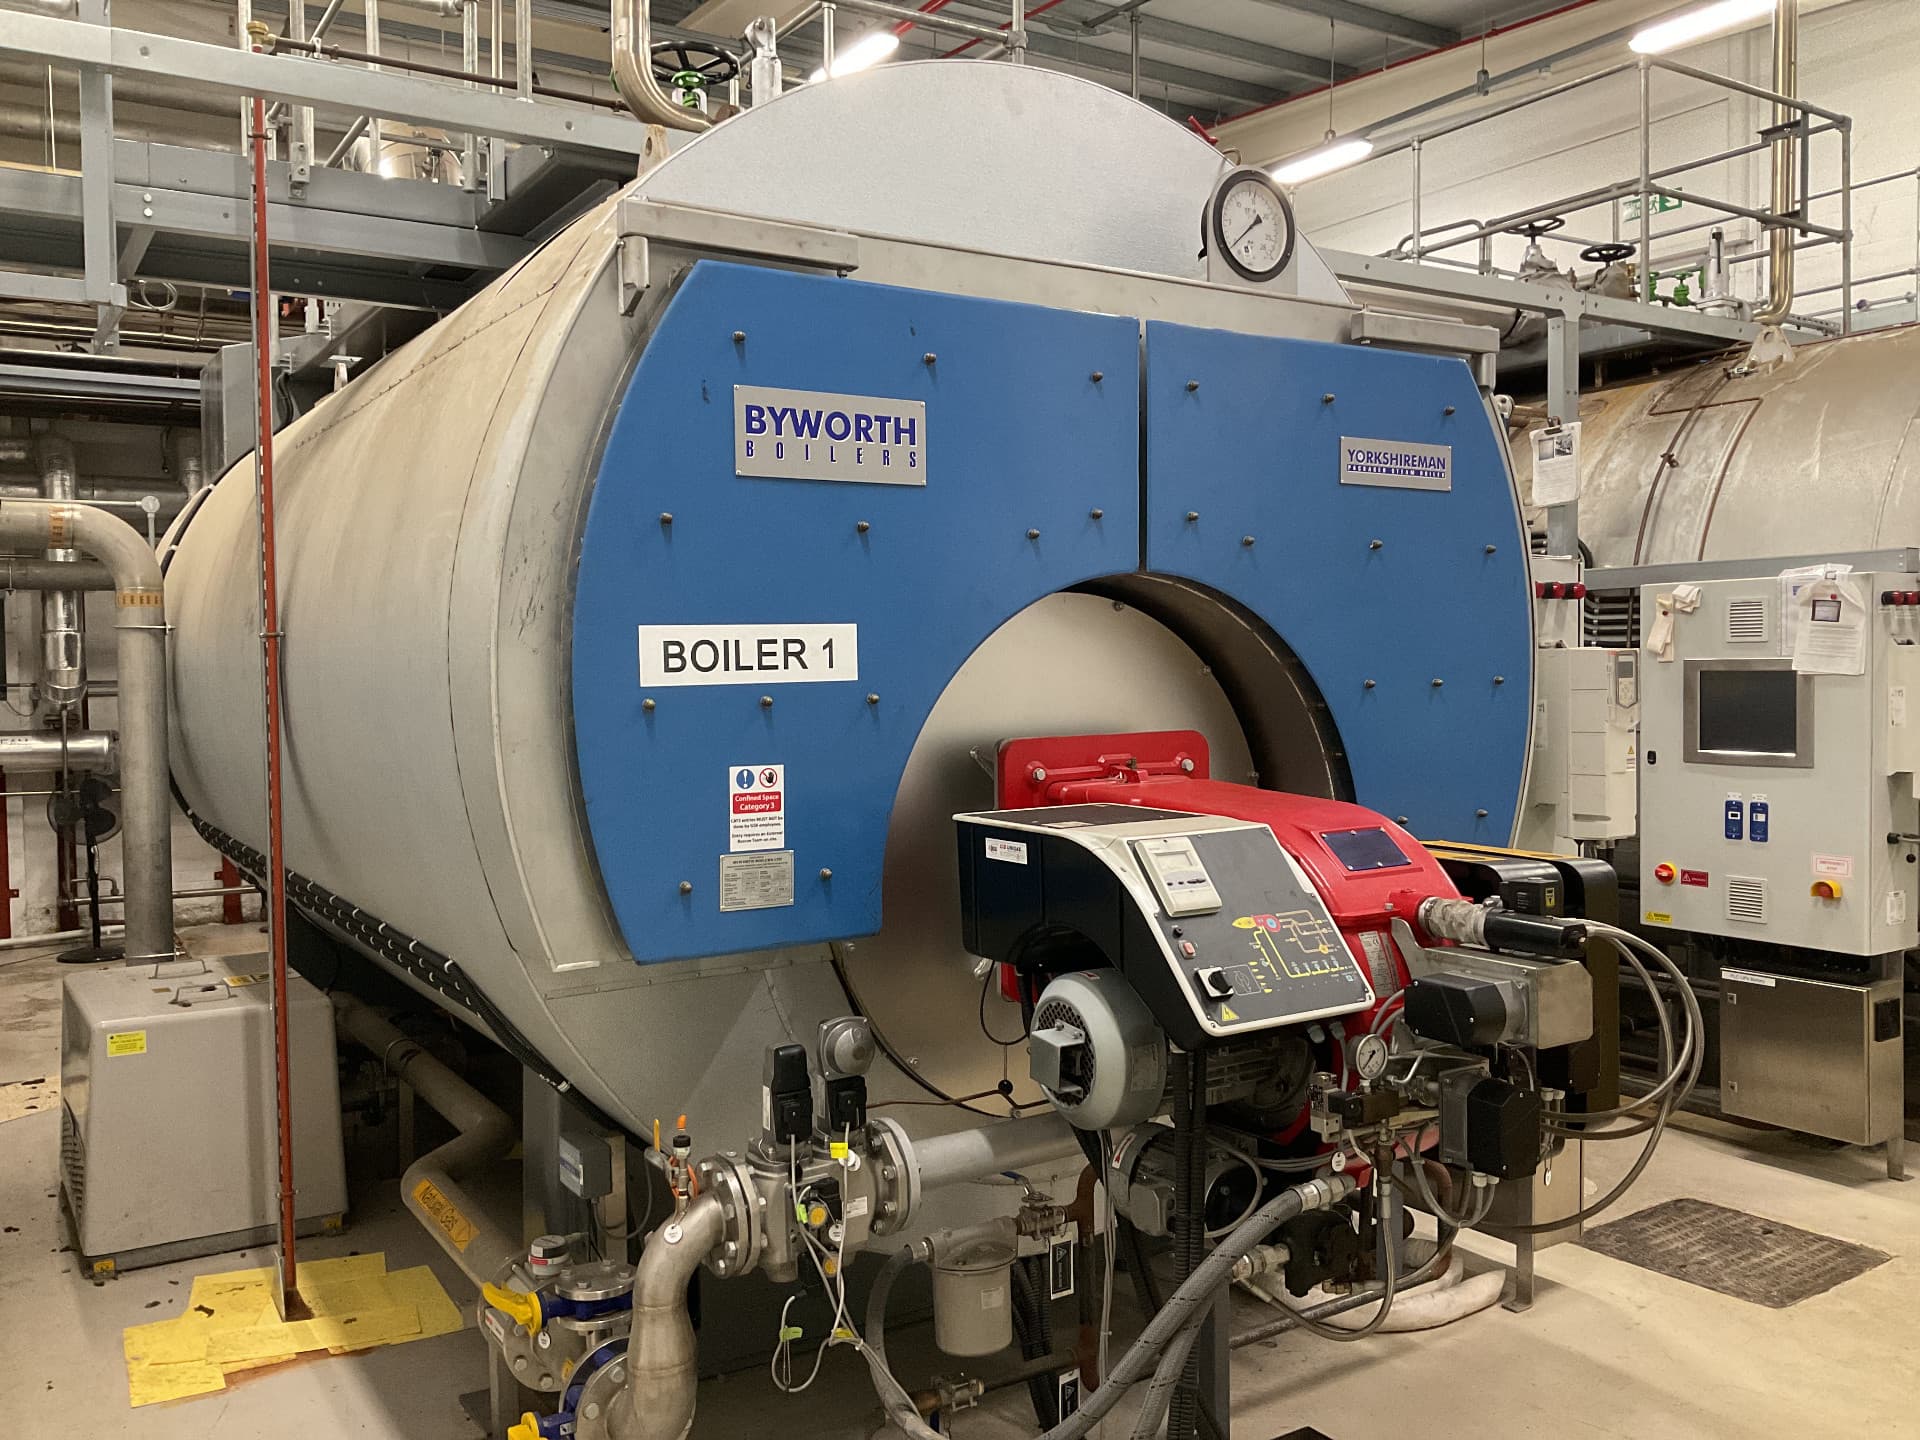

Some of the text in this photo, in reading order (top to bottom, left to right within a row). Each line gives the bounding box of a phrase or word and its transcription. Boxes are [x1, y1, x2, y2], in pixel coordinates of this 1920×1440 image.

[745, 404, 917, 447] BYWORTH
[745, 440, 917, 468] BOILERS
[1347, 448, 1446, 470] YORKSHIREMAN
[663, 637, 834, 673] BOILER 1
[735, 794, 779, 802] Confined Space
[739, 803, 769, 811] Category
